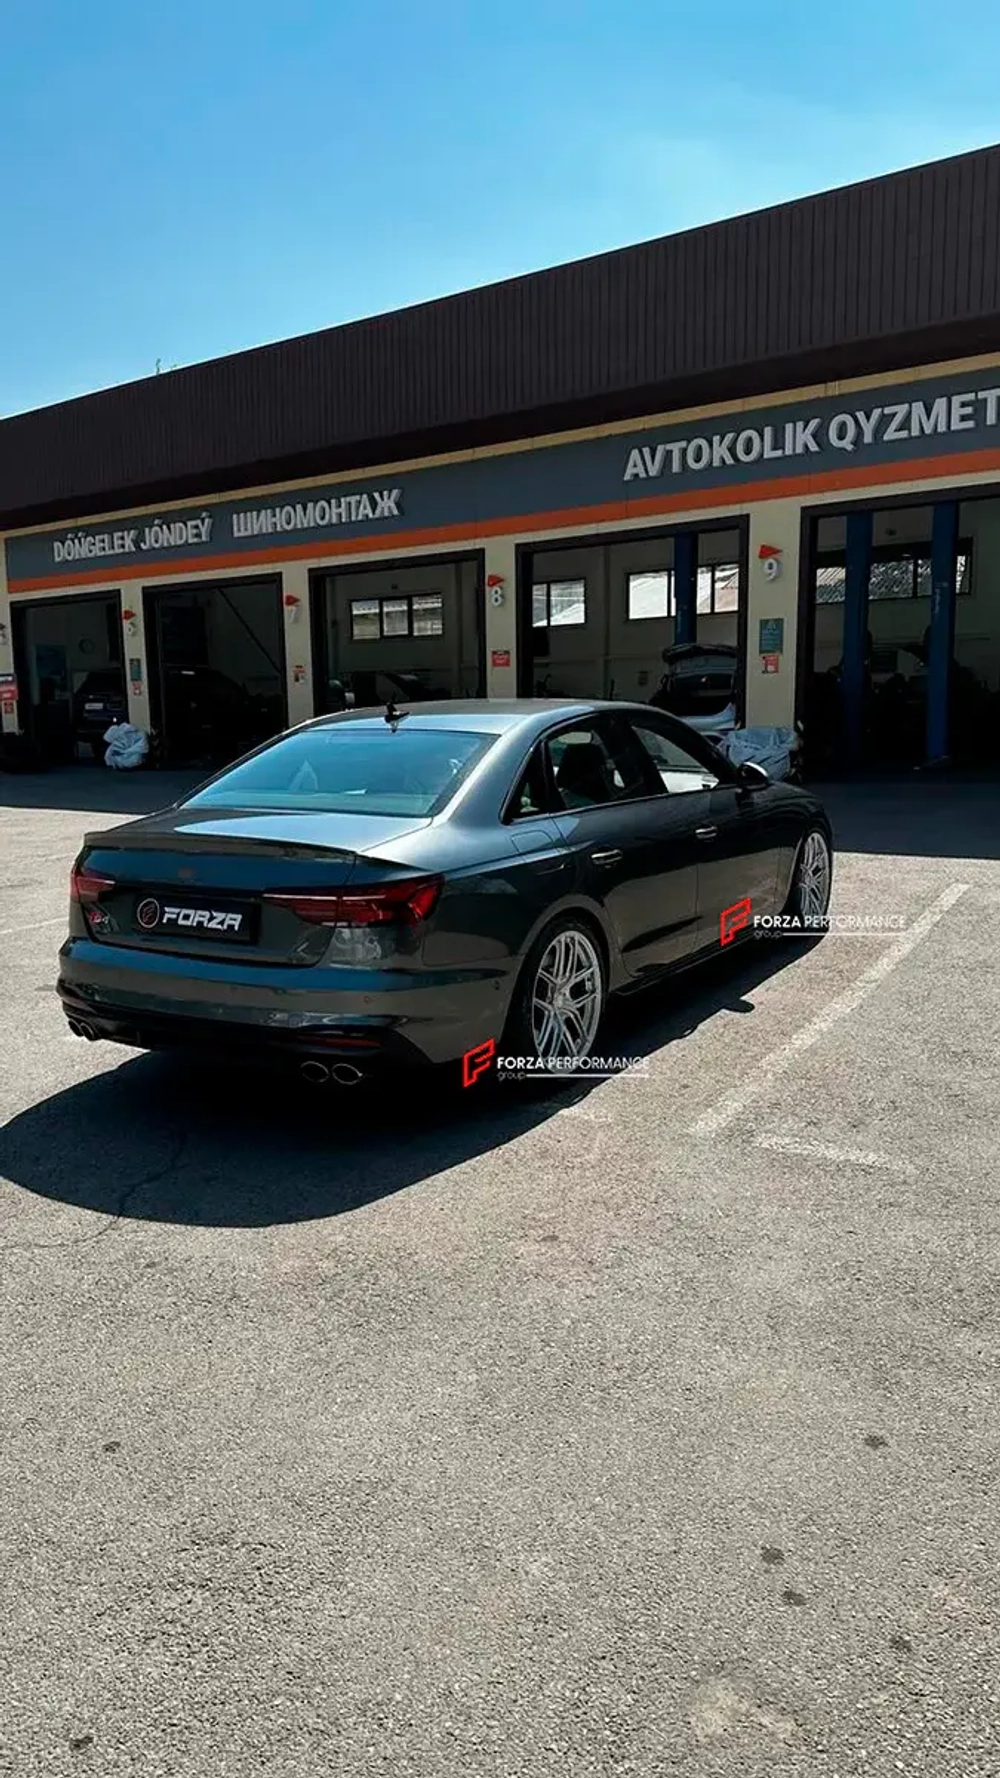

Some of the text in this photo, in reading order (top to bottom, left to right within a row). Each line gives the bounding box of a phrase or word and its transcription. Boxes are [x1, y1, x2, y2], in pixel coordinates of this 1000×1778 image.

[623, 388, 1000, 481] AVTOKOLIK QYZMET
[232, 488, 401, 537] ШИНОМОНТАЖ
[764, 558, 778, 581] 9
[491, 586, 503, 606] 8
[162, 906, 243, 931] FORZA
